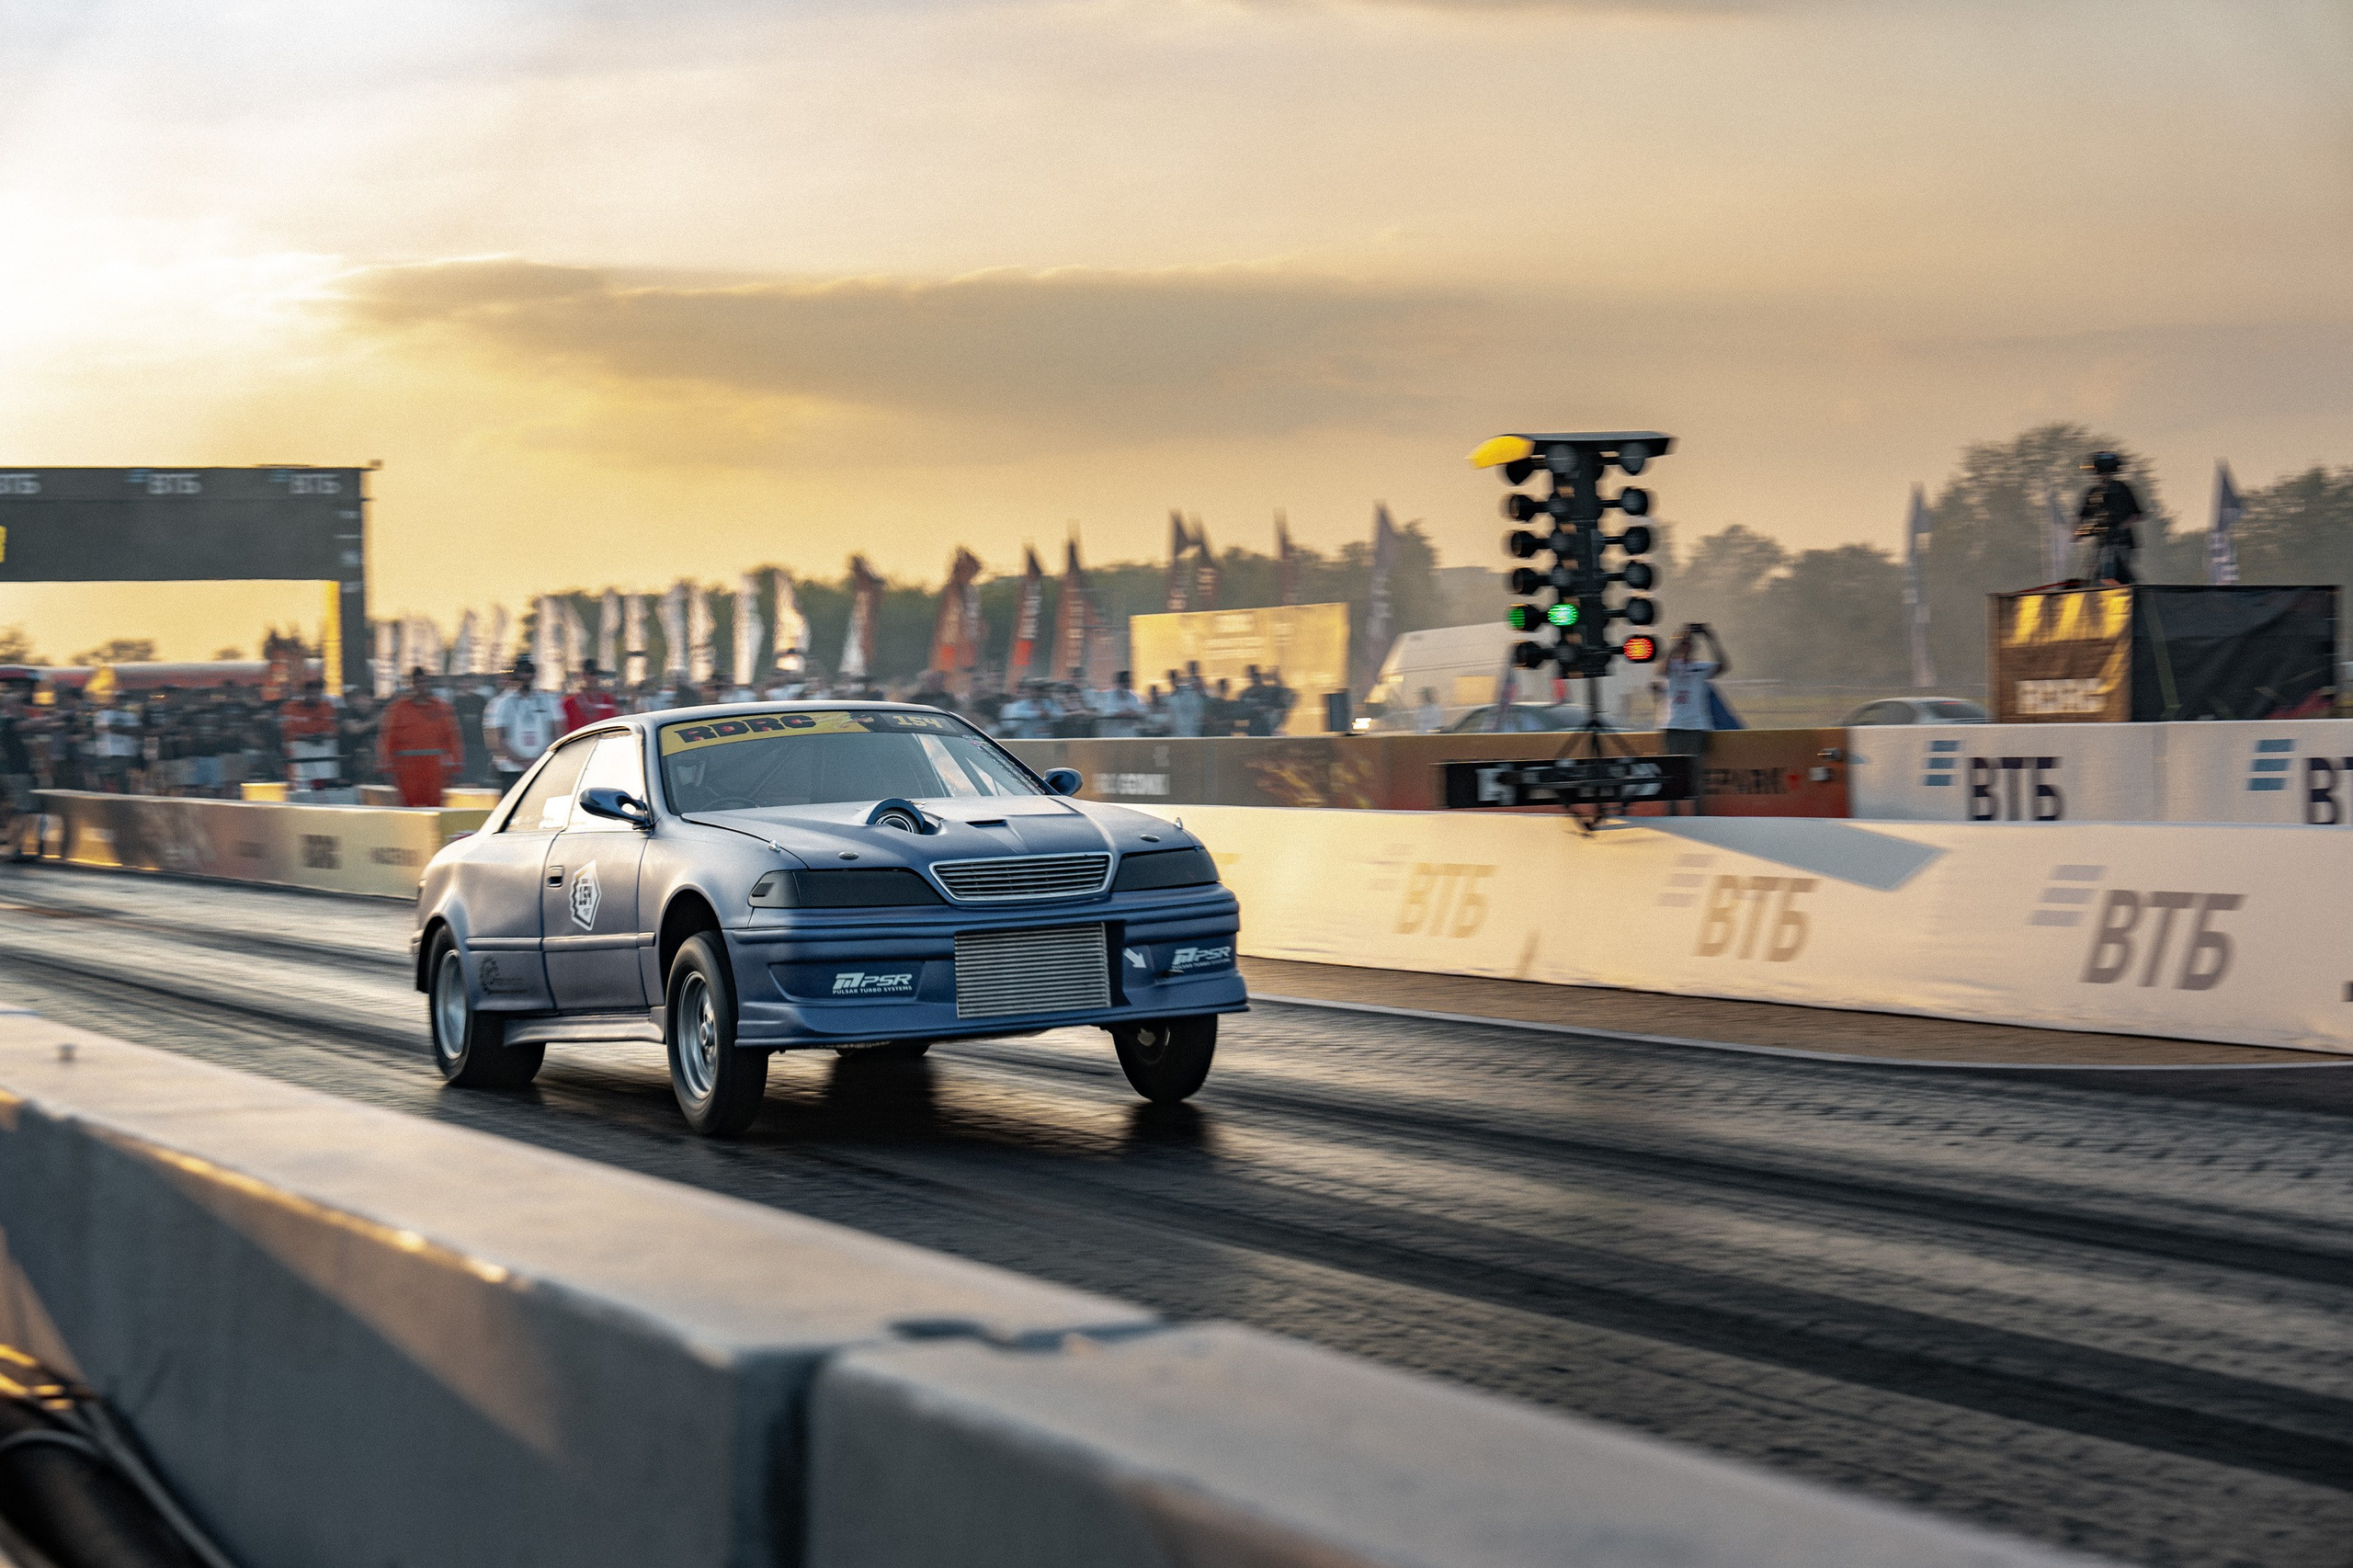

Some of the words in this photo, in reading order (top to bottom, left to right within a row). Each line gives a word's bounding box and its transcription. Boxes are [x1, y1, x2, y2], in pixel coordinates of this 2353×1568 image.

[674, 715, 816, 743] RDRC
[892, 715, 943, 729] 154
[1967, 747, 2064, 821] ВТБ
[1392, 861, 1499, 938] ВТБ
[1691, 874, 1820, 962] ВТБ
[2079, 889, 2257, 992] ВТБ
[860, 973, 913, 988] PSR
[883, 984, 913, 993] SYSTEMS
